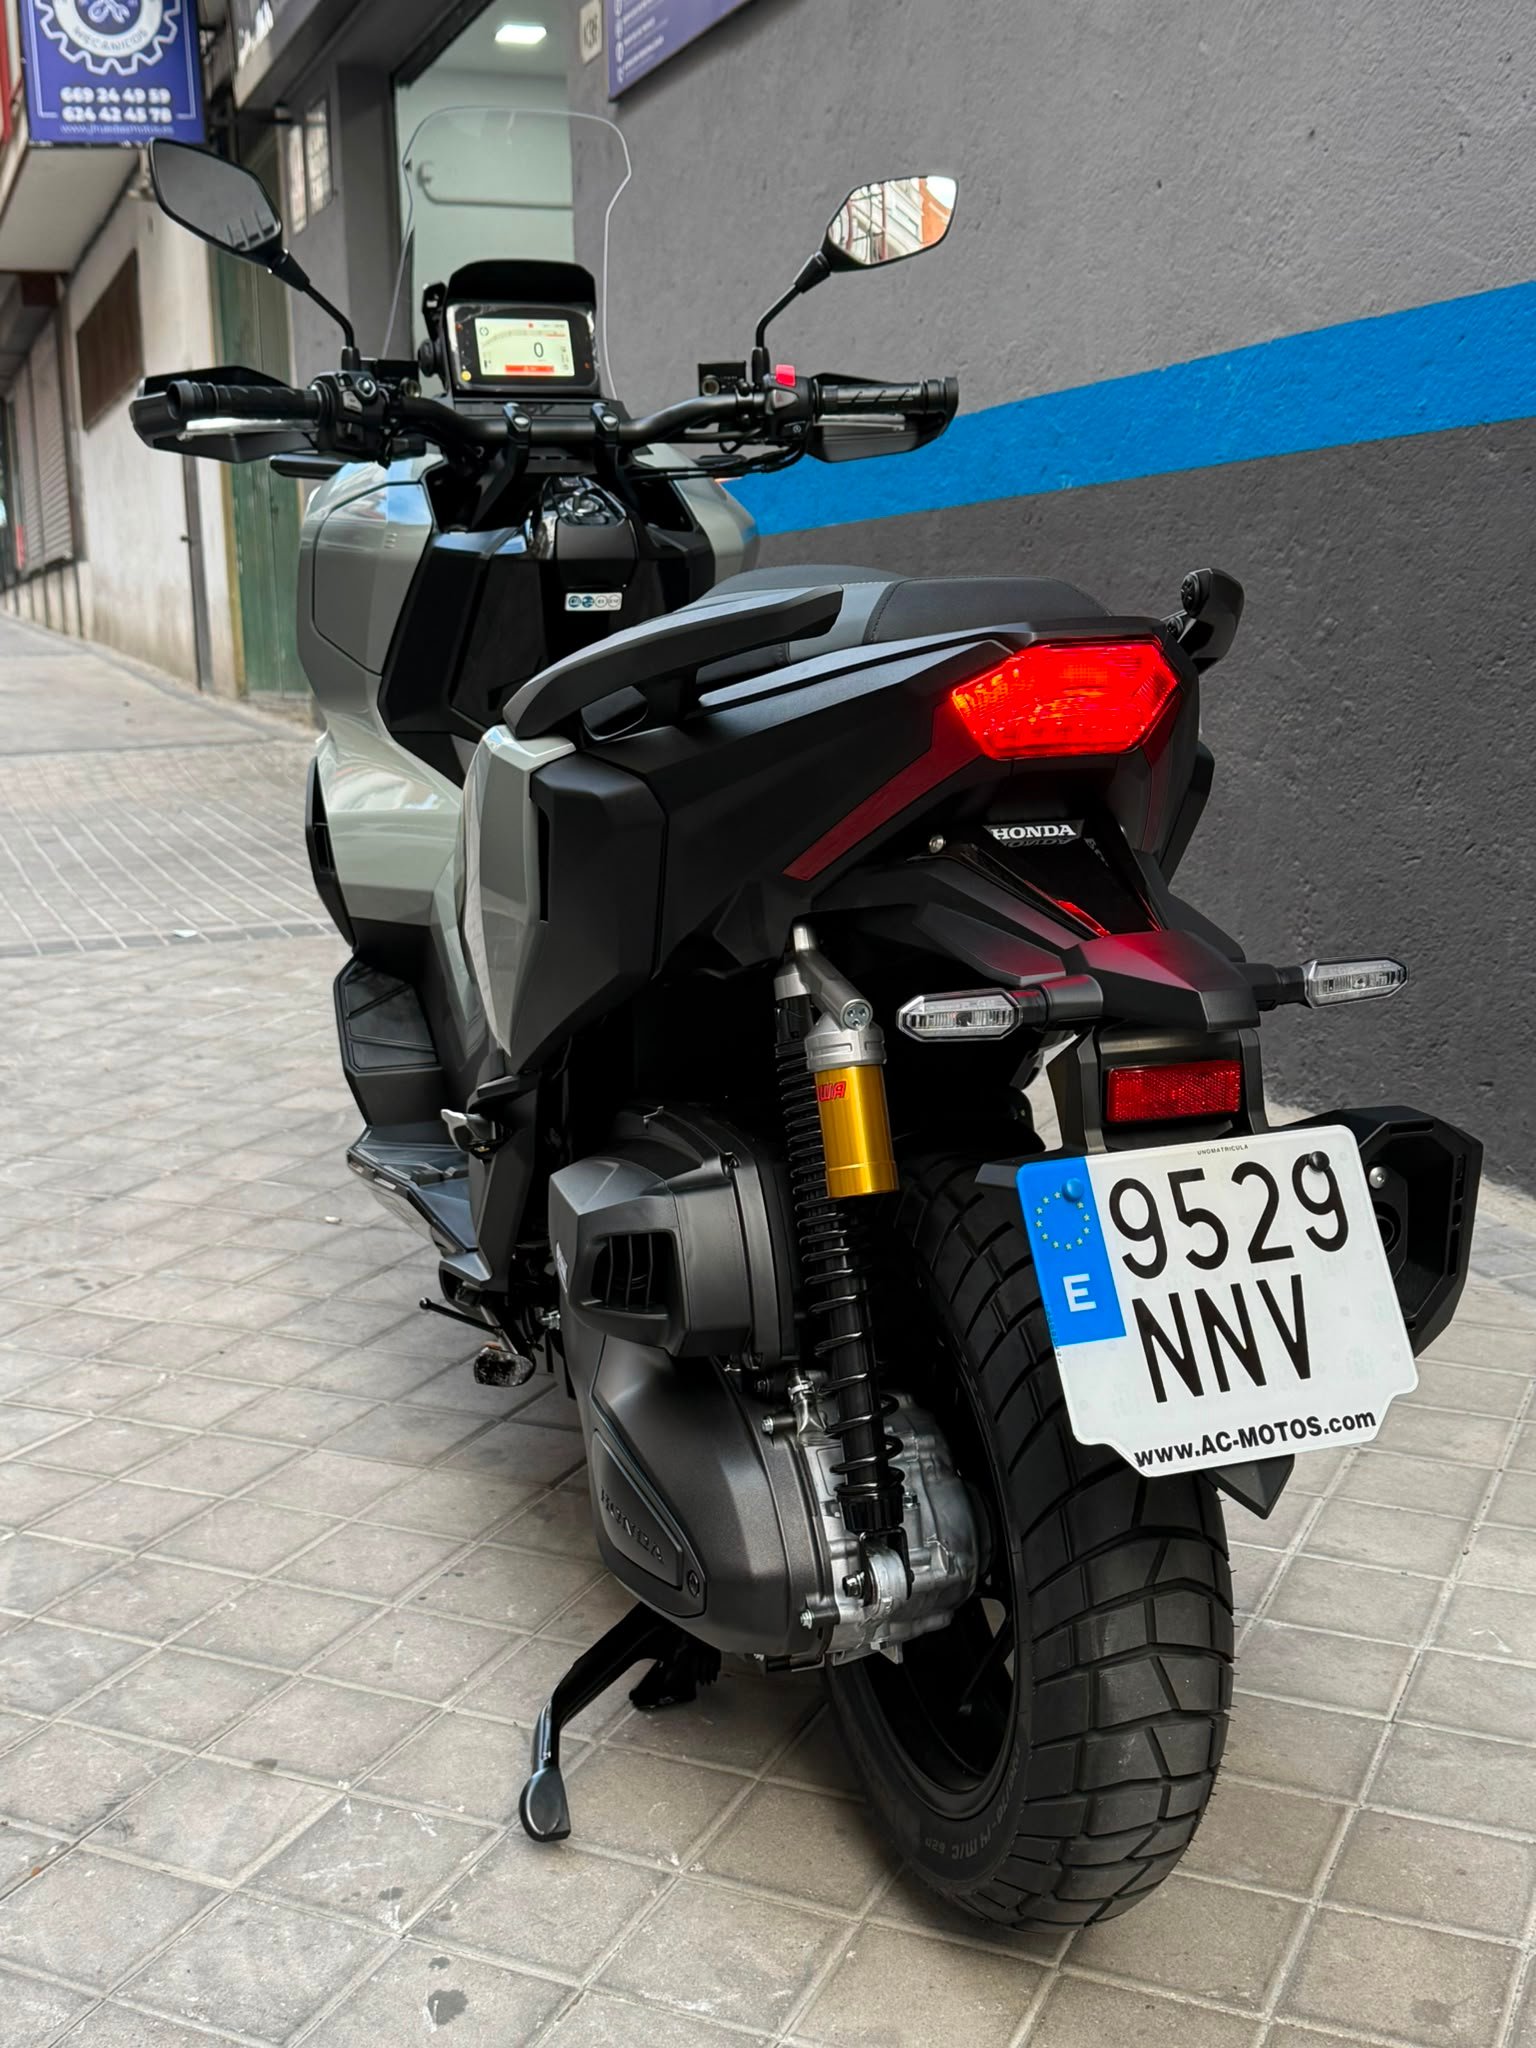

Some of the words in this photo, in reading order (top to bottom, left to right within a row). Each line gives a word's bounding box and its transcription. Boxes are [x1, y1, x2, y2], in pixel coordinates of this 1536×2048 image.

[990, 824, 1076, 840] HONDA
[1109, 1152, 1349, 1279] 9529
[1063, 1273, 1097, 1313] E
[1132, 1274, 1311, 1404] NNV
[1134, 1411, 1377, 1467] www.AC-MOTOS.com
